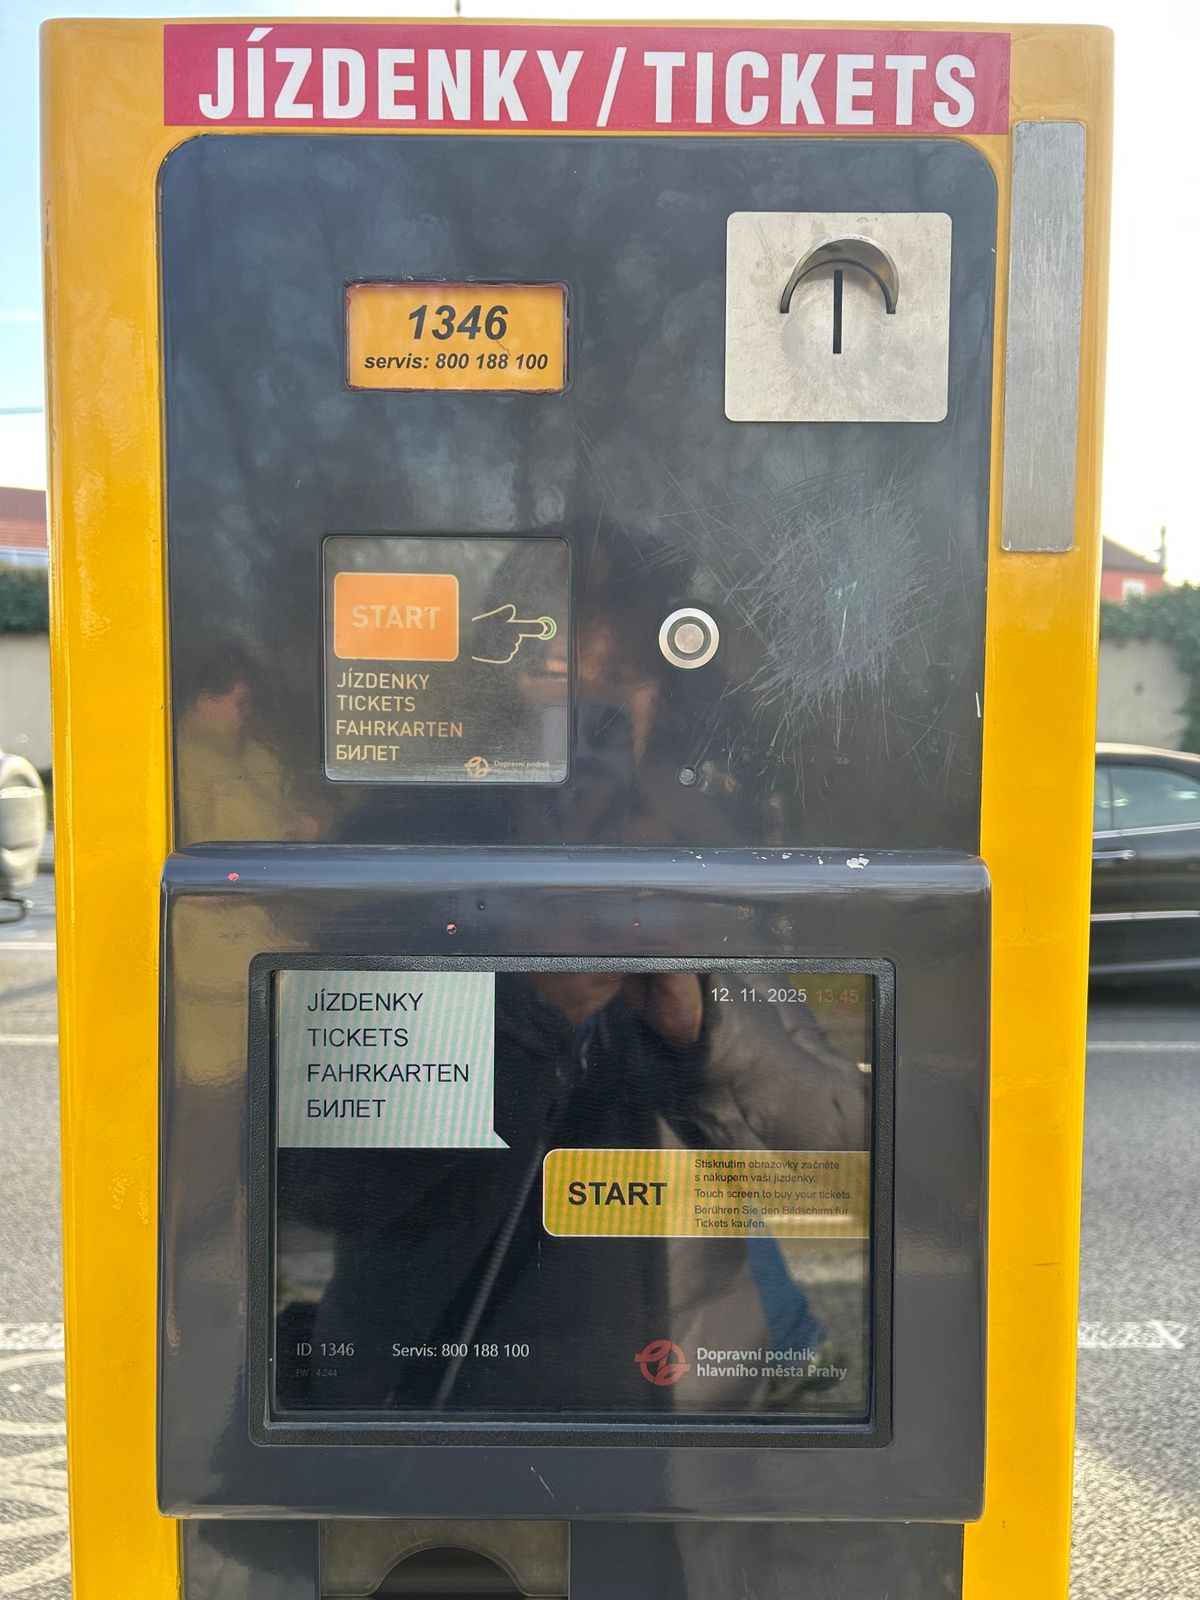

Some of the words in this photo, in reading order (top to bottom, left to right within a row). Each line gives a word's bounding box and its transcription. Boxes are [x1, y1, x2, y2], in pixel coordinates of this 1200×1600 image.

[199, 27, 585, 121] JÍZDENKY
[597, 46, 626, 127] /
[644, 51, 976, 128] TICKETS
[408, 304, 509, 341] 1346
[364, 353, 430, 370] servis:
[435, 353, 470, 370] 800
[475, 353, 509, 370] 188
[515, 353, 549, 370] 100
[351, 603, 441, 630] START
[336, 668, 431, 690] JÍZDENKY
[336, 694, 417, 712] TICKETS
[335, 719, 464, 738] FAHRKARTEN
[335, 744, 400, 761] БИЛЕТ
[307, 988, 423, 1012] JÍZDENKY
[711, 988, 734, 1002] 12.
[741, 988, 762, 1002] 11.
[767, 988, 808, 1003] 2025
[816, 989, 859, 1004] 13:45
[307, 1028, 409, 1047] TICKETS
[307, 1063, 469, 1083] FAHRKARTEN
[307, 1099, 387, 1118] БИЛЕТ
[748, 1159, 799, 1171] obrazovky
[694, 1174, 700, 1182] s
[568, 1182, 667, 1206] START
[695, 1188, 723, 1198] Touch
[727, 1190, 759, 1199] screen
[762, 1190, 772, 1199] to
[774, 1190, 792, 1200] buy
[795, 1191, 816, 1201] your
[819, 1190, 854, 1200] tickets.
[694, 1205, 740, 1215] Berühren
[742, 1205, 758, 1215] Sie
[761, 1206, 780, 1215] den
[782, 1205, 833, 1216] Bildschirm
[835, 1206, 849, 1216] für
[695, 1219, 729, 1228] Tickets
[296, 1343, 312, 1356] ID
[320, 1343, 355, 1356] 1346
[392, 1343, 437, 1357] Servis:
[441, 1343, 468, 1357] 800
[473, 1343, 499, 1357] 188
[504, 1343, 529, 1357] 100
[697, 1348, 761, 1362] Dopravní
[765, 1348, 814, 1362] podnik
[296, 1368, 309, 1376] FW
[697, 1364, 757, 1376] hlavního
[761, 1364, 804, 1377] města
[807, 1365, 847, 1381] Prahy
